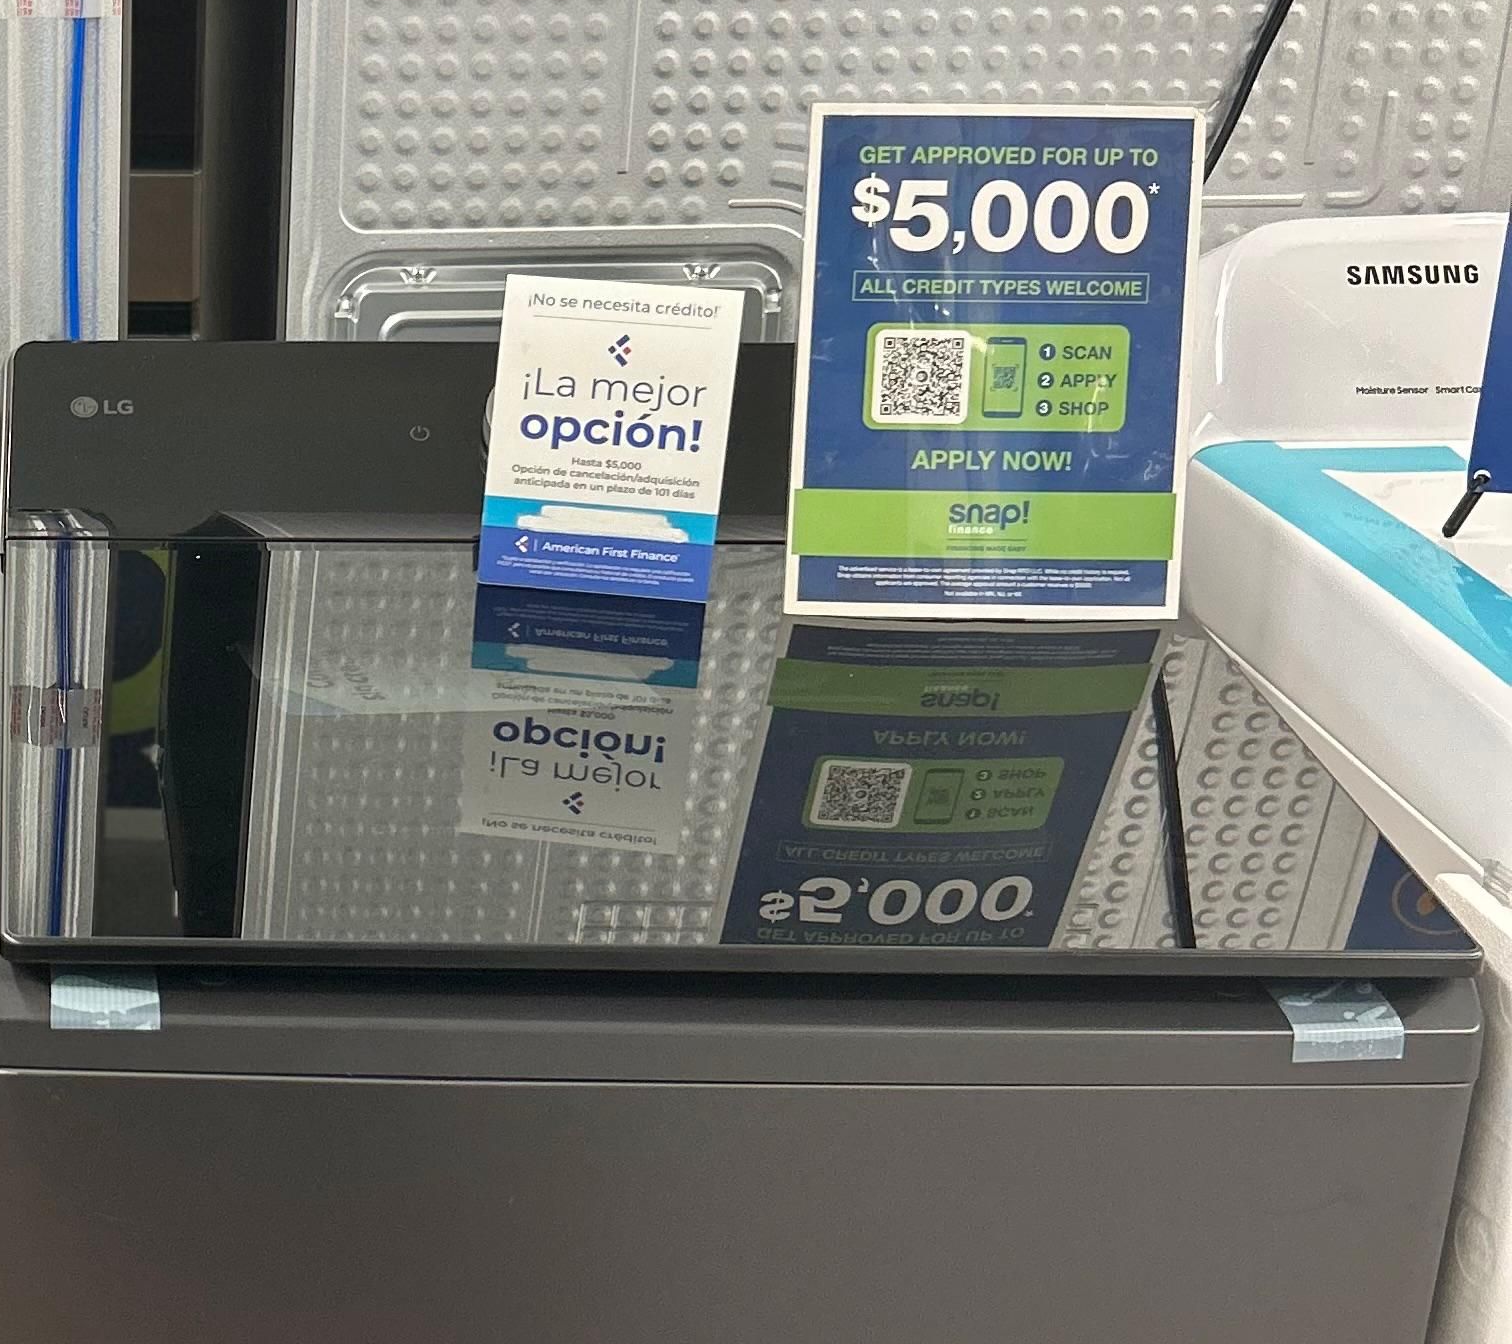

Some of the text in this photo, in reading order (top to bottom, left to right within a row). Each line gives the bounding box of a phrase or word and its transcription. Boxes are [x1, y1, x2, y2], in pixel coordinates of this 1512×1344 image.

[859, 146, 1159, 167] GET APPROVED FOR UP TO
[1346, 264, 1479, 286] SAMSUNG
[860, 278, 1142, 297] ALL CREDIT TYPES WELCOME
[559, 296, 578, 309] se
[582, 298, 651, 314] necesita
[1062, 345, 1112, 361] SCAN
[522, 367, 708, 412] ¡La mejor
[1060, 373, 1117, 389] APPLY
[1396, 386, 1429, 394] Sensor
[1435, 386, 1464, 394] Smart
[103, 400, 134, 415] LG
[1058, 400, 1109, 417] SHOP
[520, 409, 703, 453] opción!
[511, 463, 551, 477] Opción
[553, 467, 567, 477] de
[571, 457, 642, 471] Hasta $5,000
[911, 450, 1072, 472] APPLY NOW!
[513, 477, 571, 489] anticipada
[572, 481, 588, 490] en
[589, 483, 604, 491] un
[606, 483, 636, 494] plazo
[637, 485, 652, 496] de
[654, 487, 670, 497] 101
[948, 500, 1030, 530] snap!
[948, 524, 994, 534] finance
[541, 541, 679, 563] American First Finance
